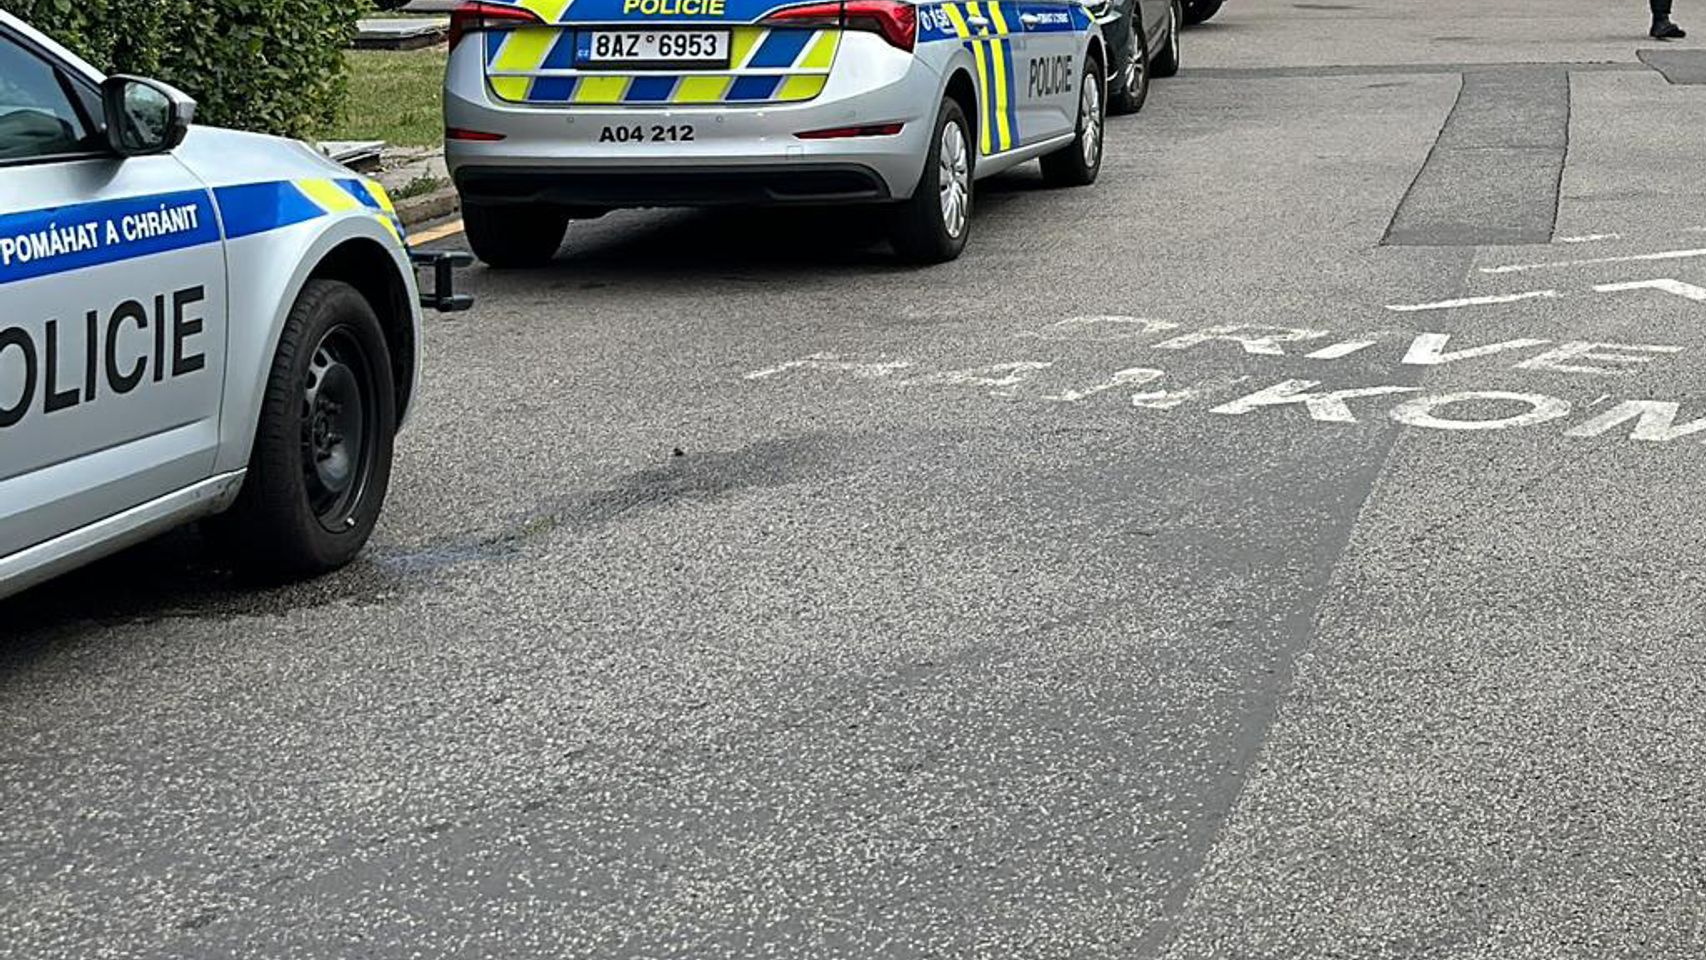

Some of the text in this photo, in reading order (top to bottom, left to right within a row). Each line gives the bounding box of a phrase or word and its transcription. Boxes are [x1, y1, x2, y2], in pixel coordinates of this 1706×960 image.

[595, 34, 718, 57] 8AZ 6953
[1028, 54, 1073, 98] POLICIE
[600, 125, 695, 143] A04 212
[1, 203, 199, 265] POMÁHAT A CHRÁNIT
